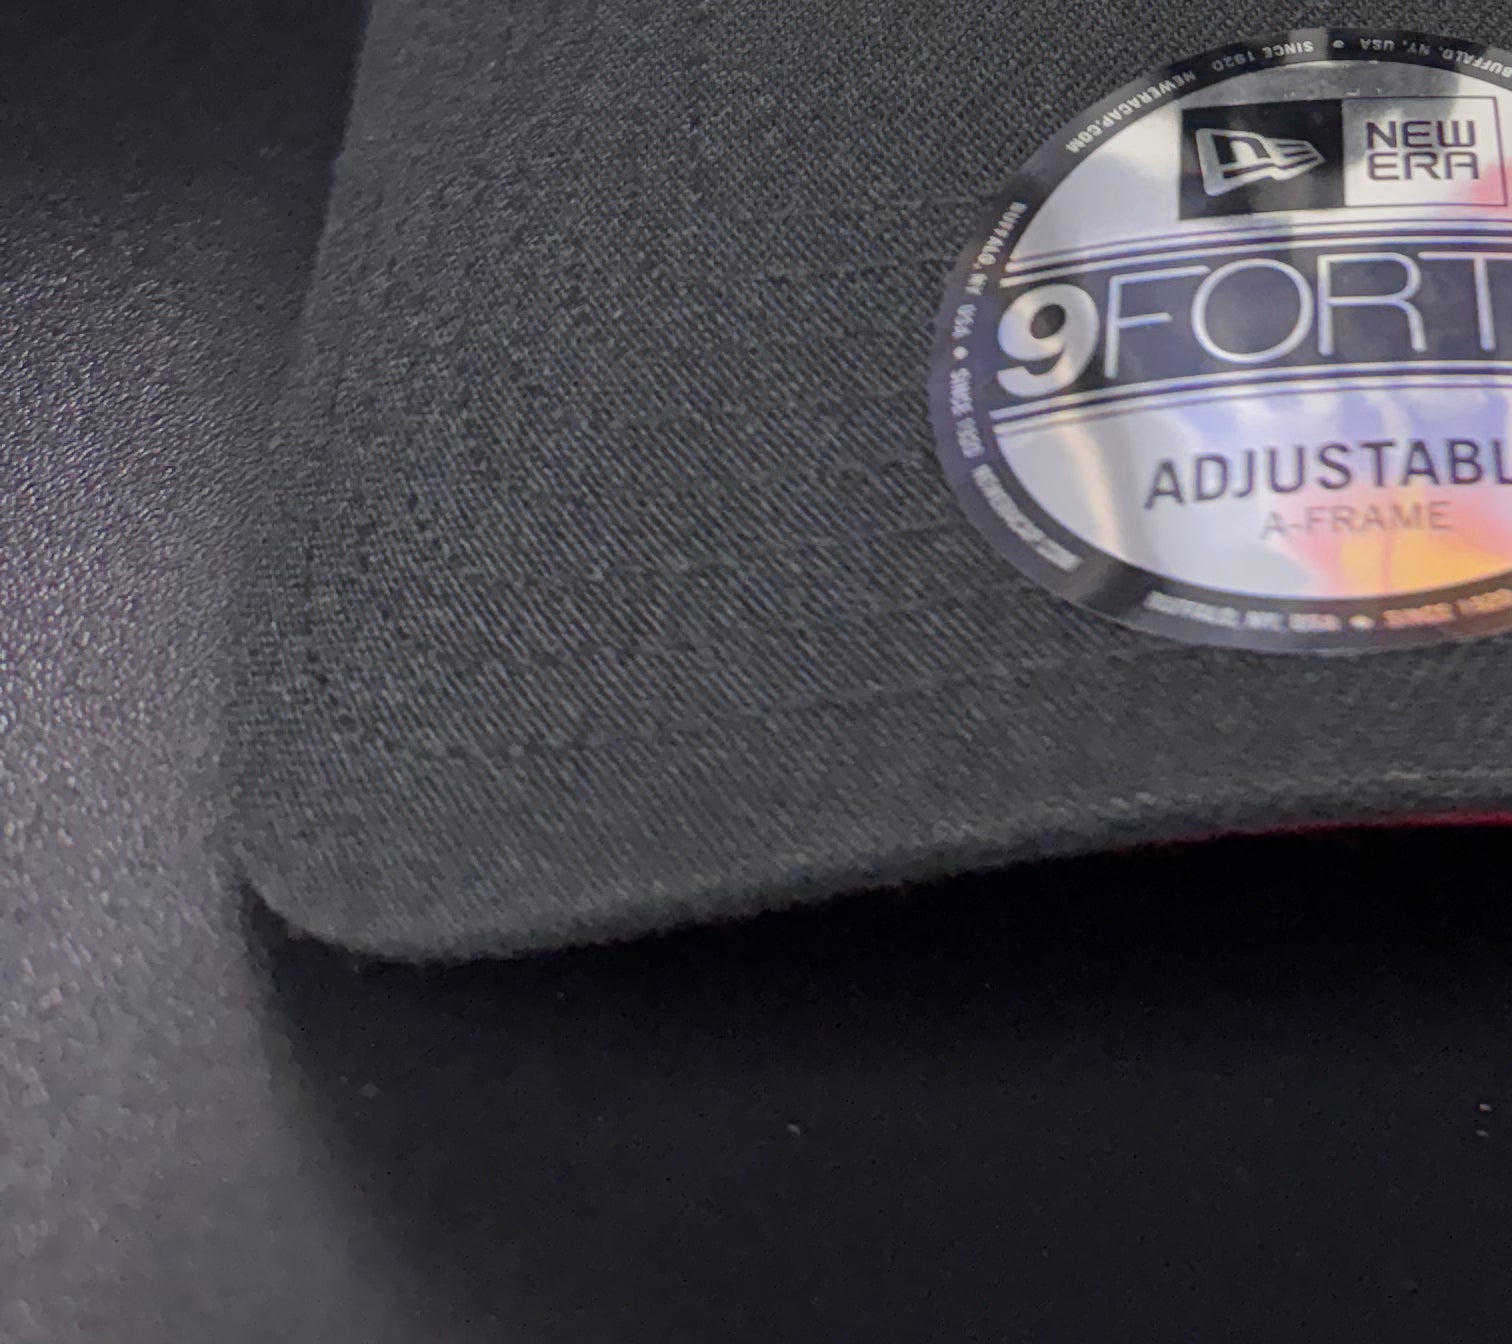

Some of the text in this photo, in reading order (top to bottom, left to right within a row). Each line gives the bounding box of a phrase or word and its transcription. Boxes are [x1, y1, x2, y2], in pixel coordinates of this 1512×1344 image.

[1262, 40, 1314, 59] SINCE
[1360, 38, 1395, 52] USA
[1211, 50, 1255, 72] 1920
[1065, 70, 1197, 154] NEWERACAP.COM
[1365, 120, 1477, 149] NEW
[1367, 151, 1480, 180] ERA
[1261, 500, 1454, 538] A-FRAME
